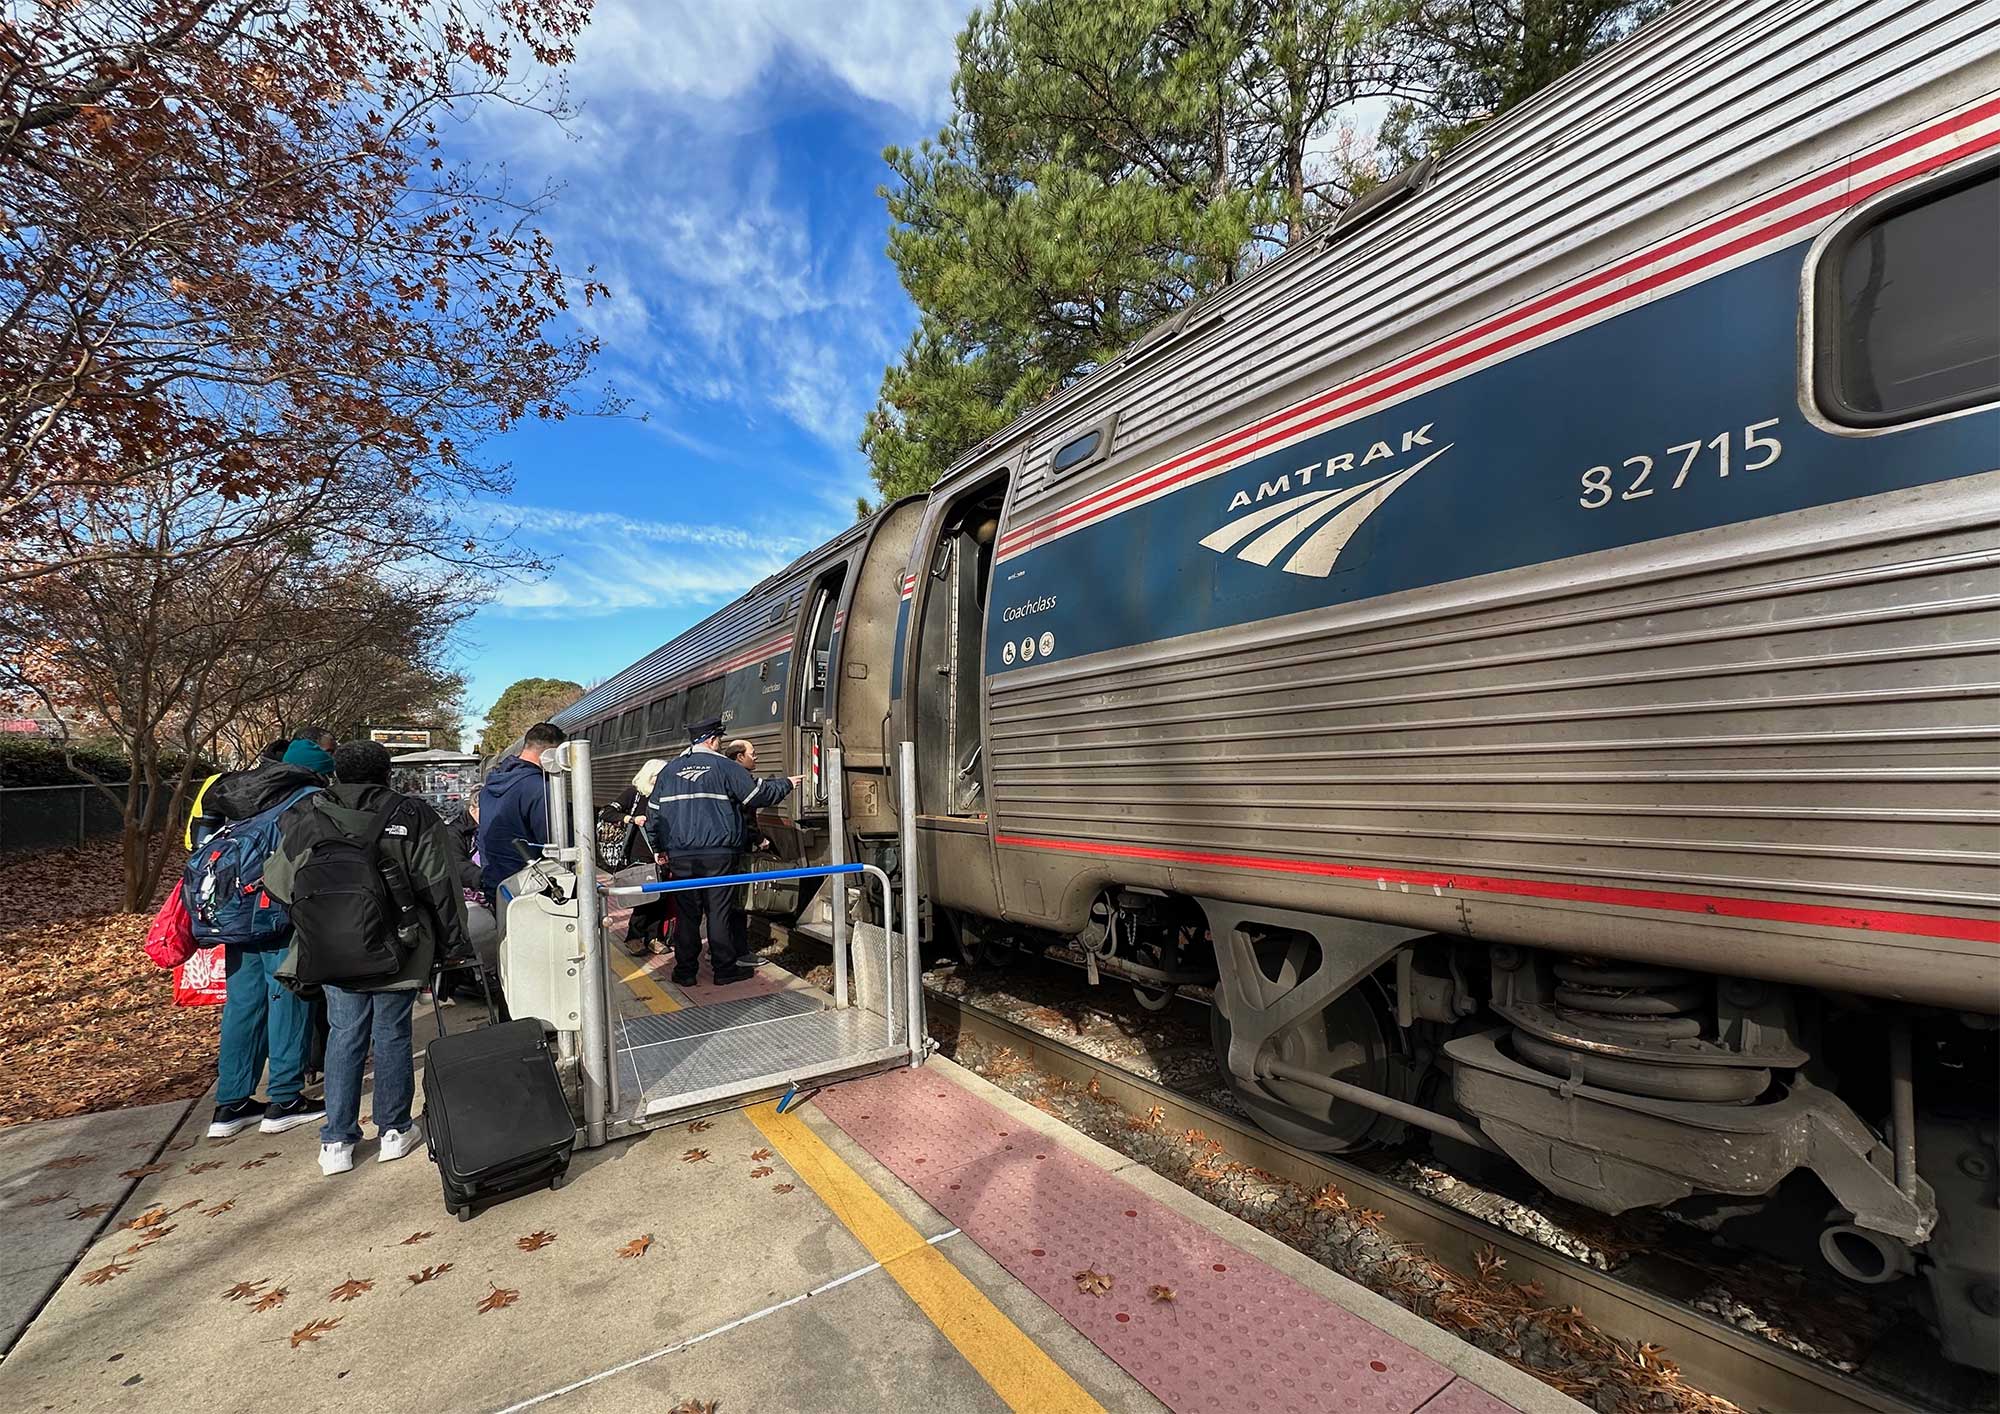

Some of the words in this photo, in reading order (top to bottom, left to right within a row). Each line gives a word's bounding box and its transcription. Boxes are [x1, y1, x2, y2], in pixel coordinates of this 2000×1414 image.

[1227, 422, 1434, 512] AMTRAK
[1580, 417, 1782, 509] 82715
[1003, 596, 1056, 622] Coachclass
